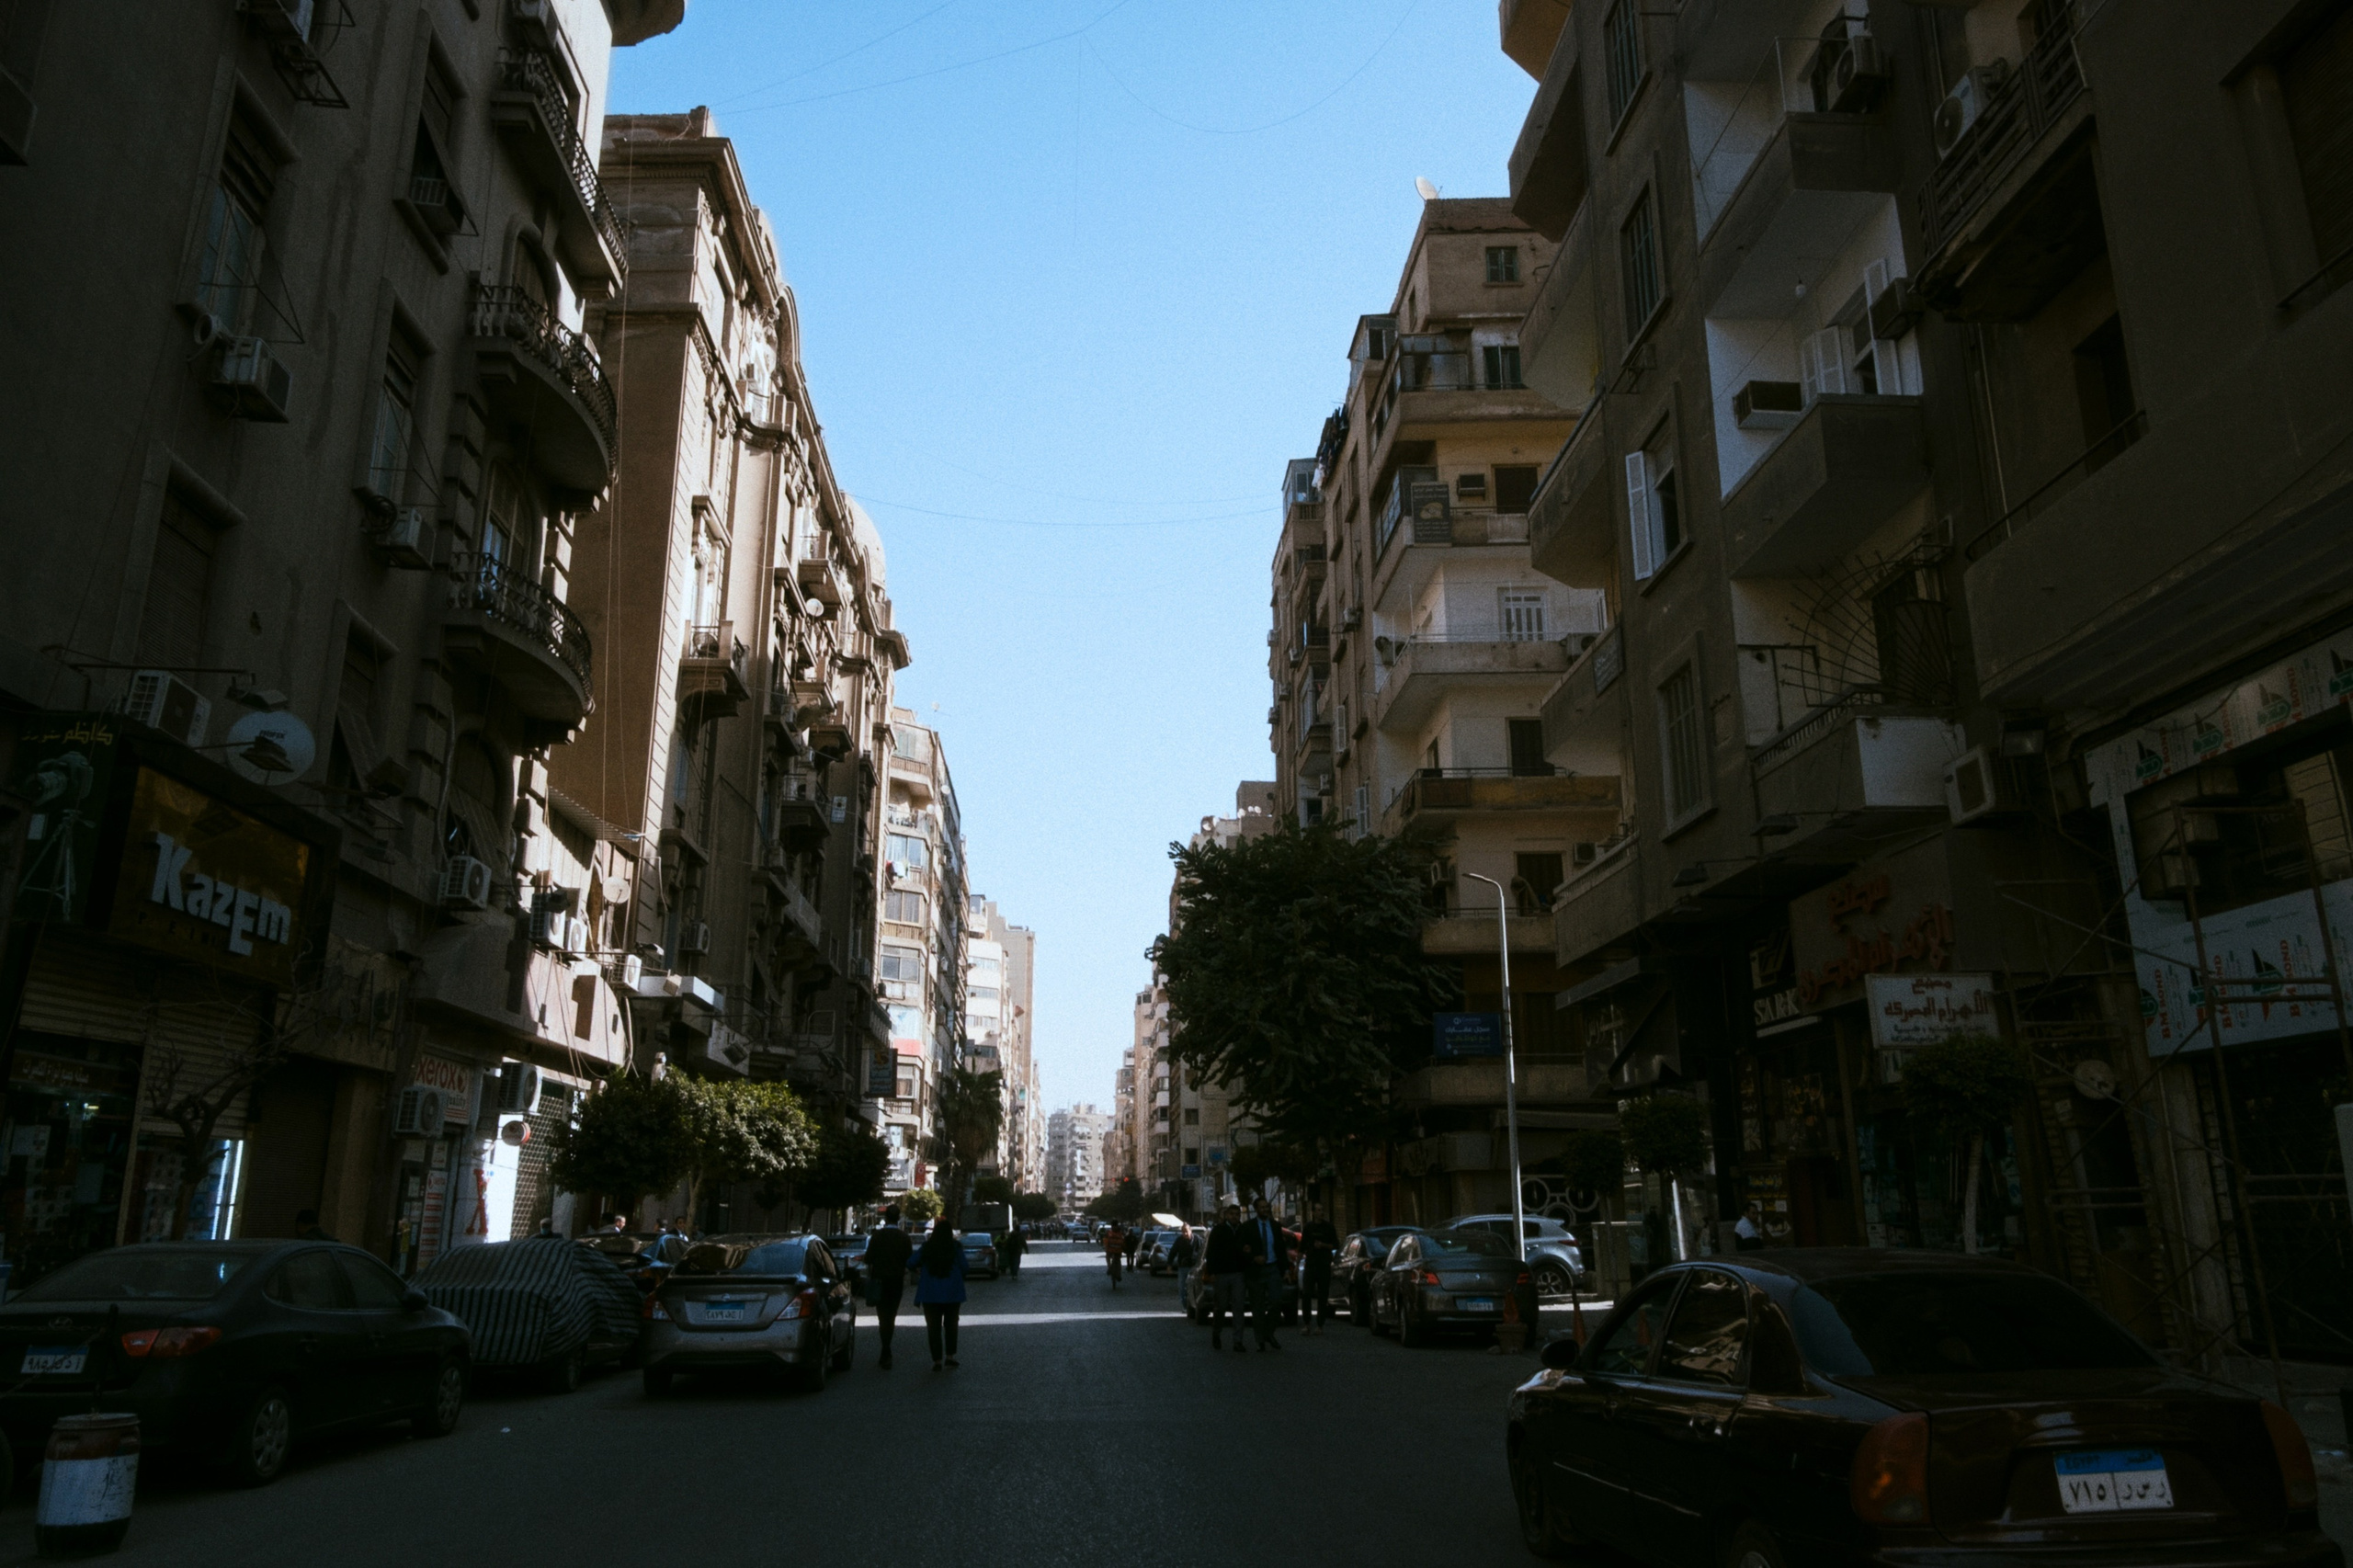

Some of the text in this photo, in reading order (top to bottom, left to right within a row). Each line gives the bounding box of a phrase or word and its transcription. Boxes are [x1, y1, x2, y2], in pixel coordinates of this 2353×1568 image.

[61, 721, 114, 745] كاظم
[1754, 986, 1800, 1026] SARK
[2154, 969, 2172, 1040] BM BOND
[415, 1056, 458, 1090] xerox
[2063, 1454, 2101, 1470] EGYPT
[2069, 1480, 2106, 1504] ٧١٥
